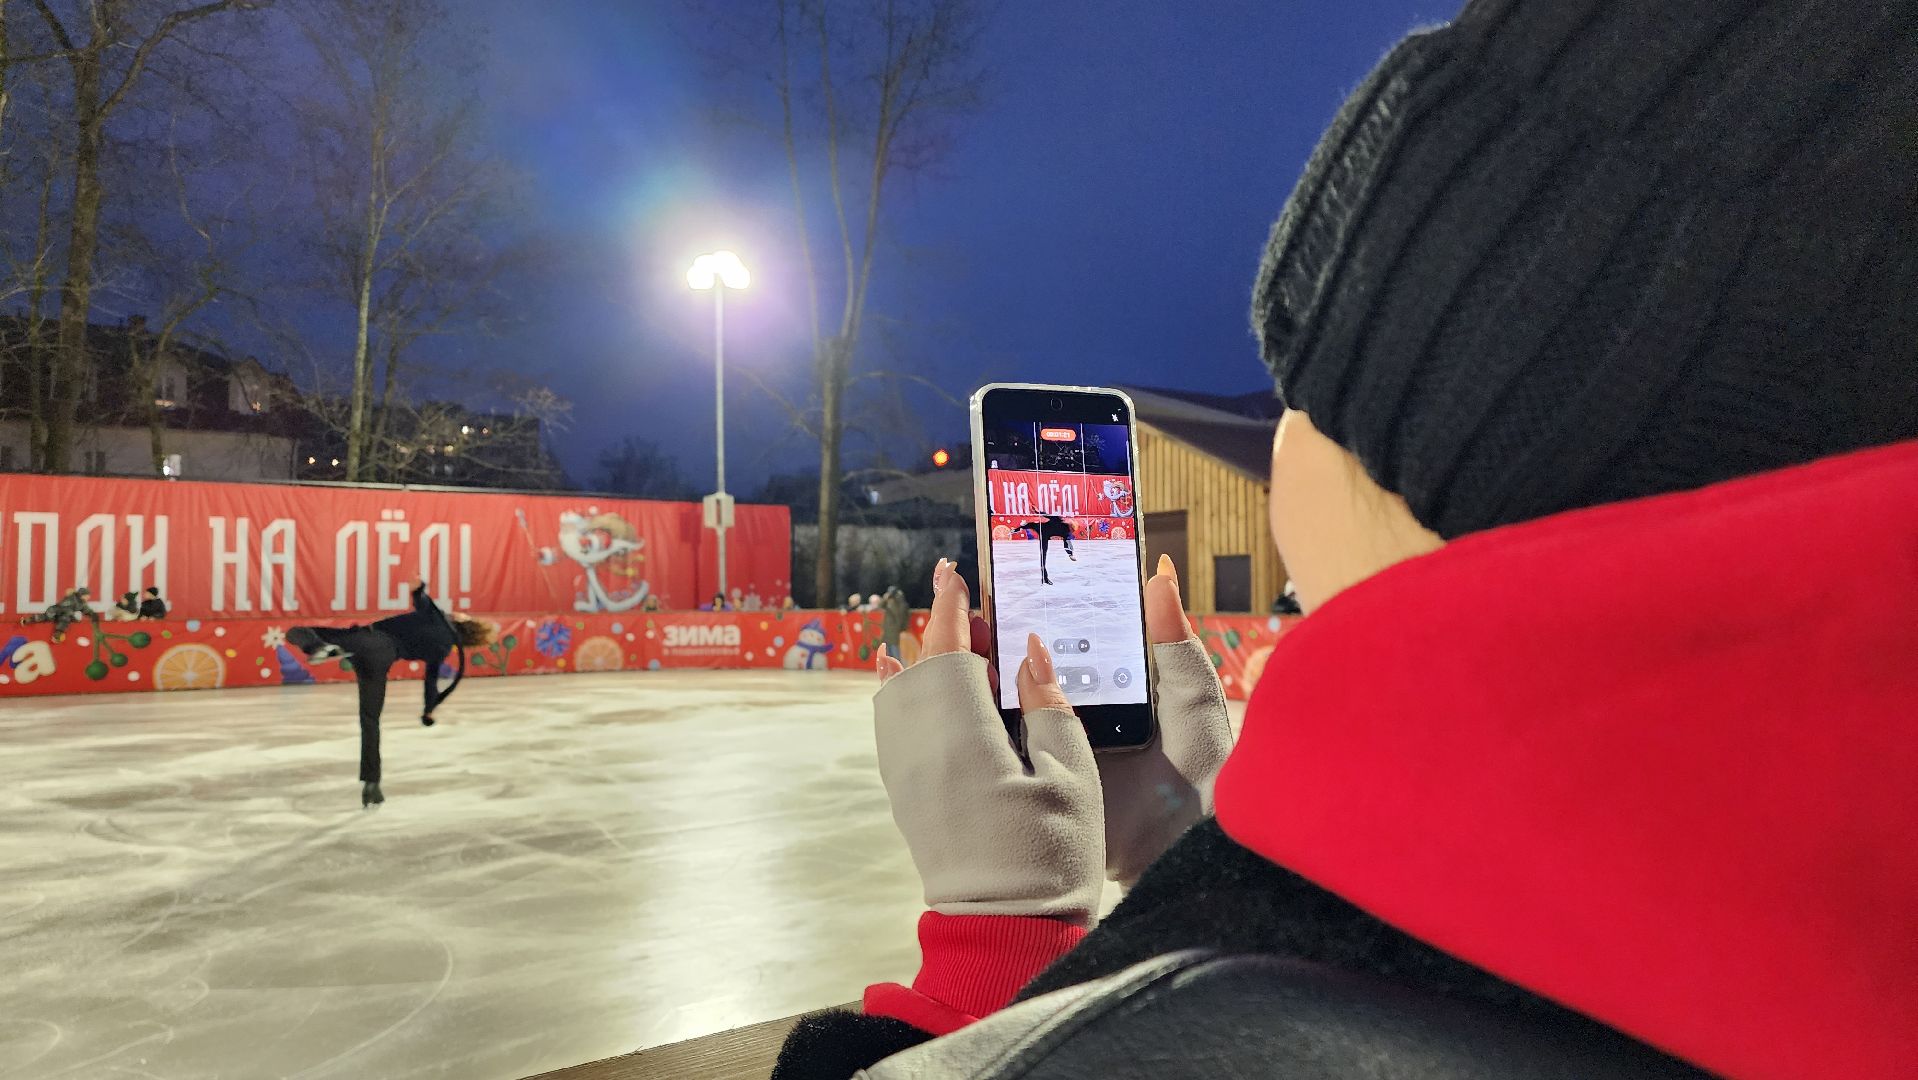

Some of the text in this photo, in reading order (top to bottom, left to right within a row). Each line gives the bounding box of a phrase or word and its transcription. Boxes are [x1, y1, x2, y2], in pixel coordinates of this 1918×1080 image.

[1003, 479, 1080, 518] НА ЛЁД!
[0, 509, 472, 621] ОДИ НА ЛЁД!
